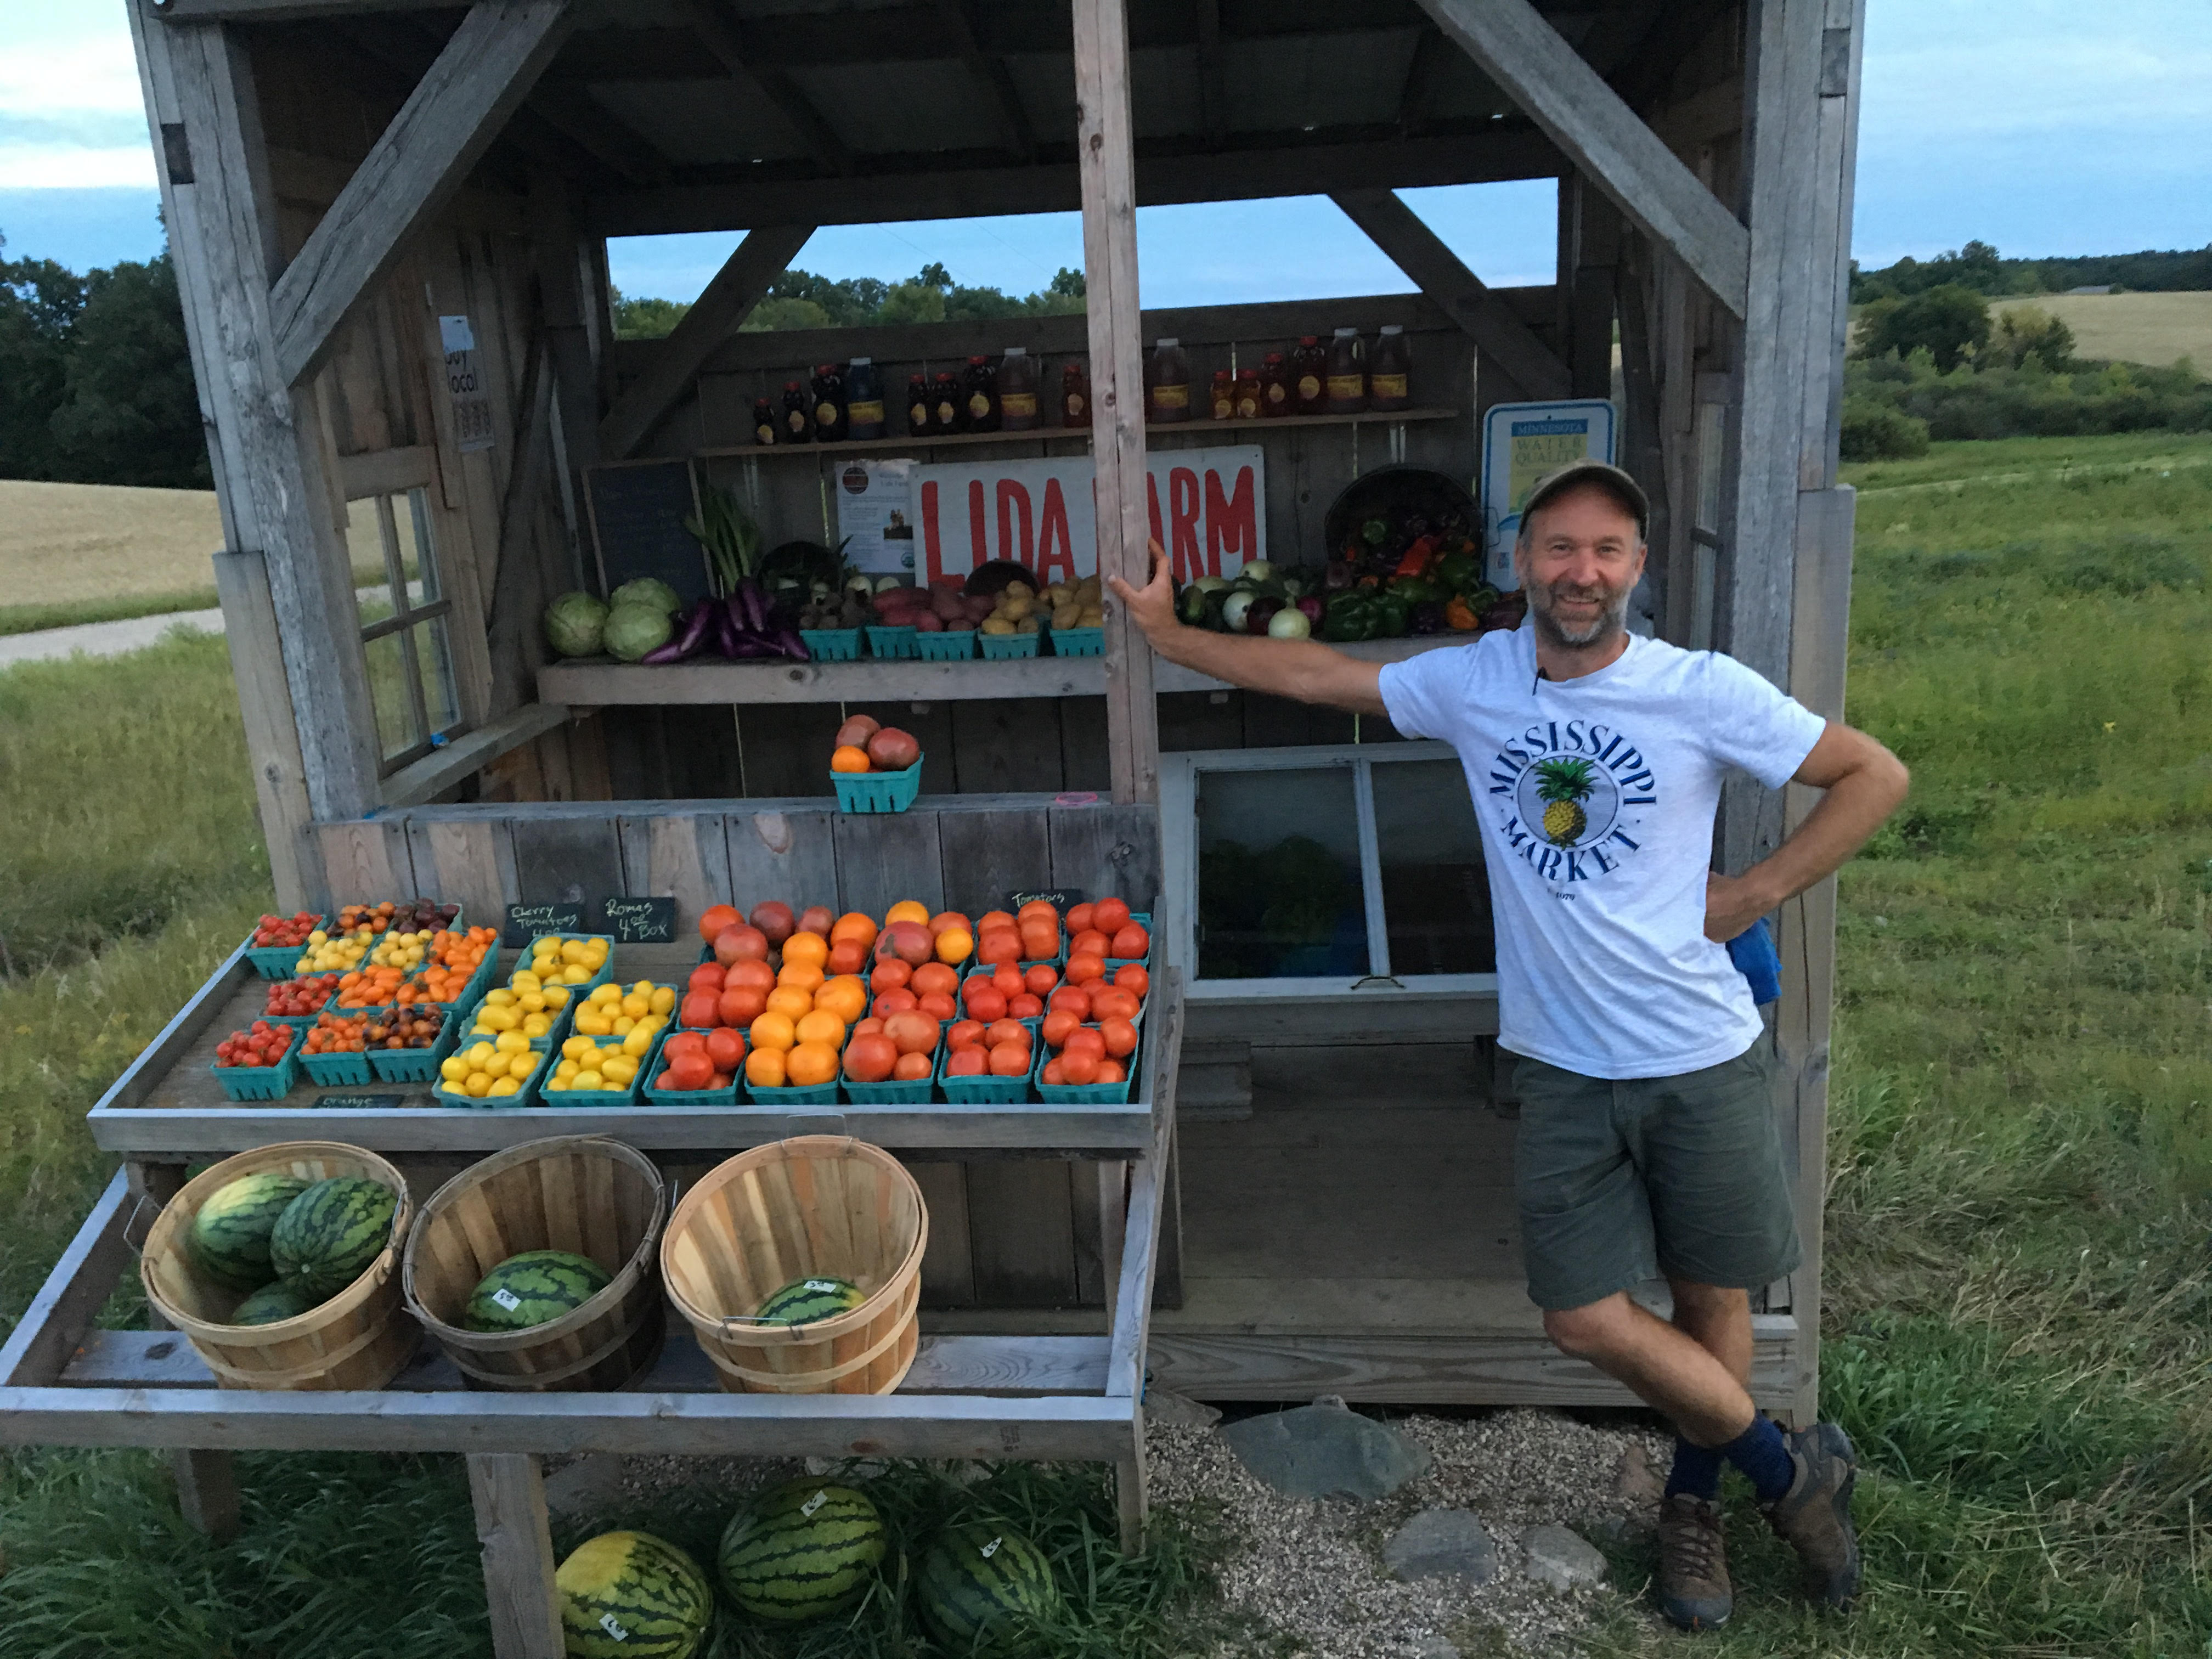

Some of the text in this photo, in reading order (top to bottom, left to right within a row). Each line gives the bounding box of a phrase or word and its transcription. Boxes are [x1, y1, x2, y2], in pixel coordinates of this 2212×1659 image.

[1517, 423, 1583, 435] MINNESOTA
[1517, 437, 1581, 450] WATER
[1516, 450, 1580, 466] QUALITY
[922, 478, 1075, 589] LIDA
[1489, 720, 1657, 806] MISSISSIPPI
[1500, 816, 1641, 882] MARKET
